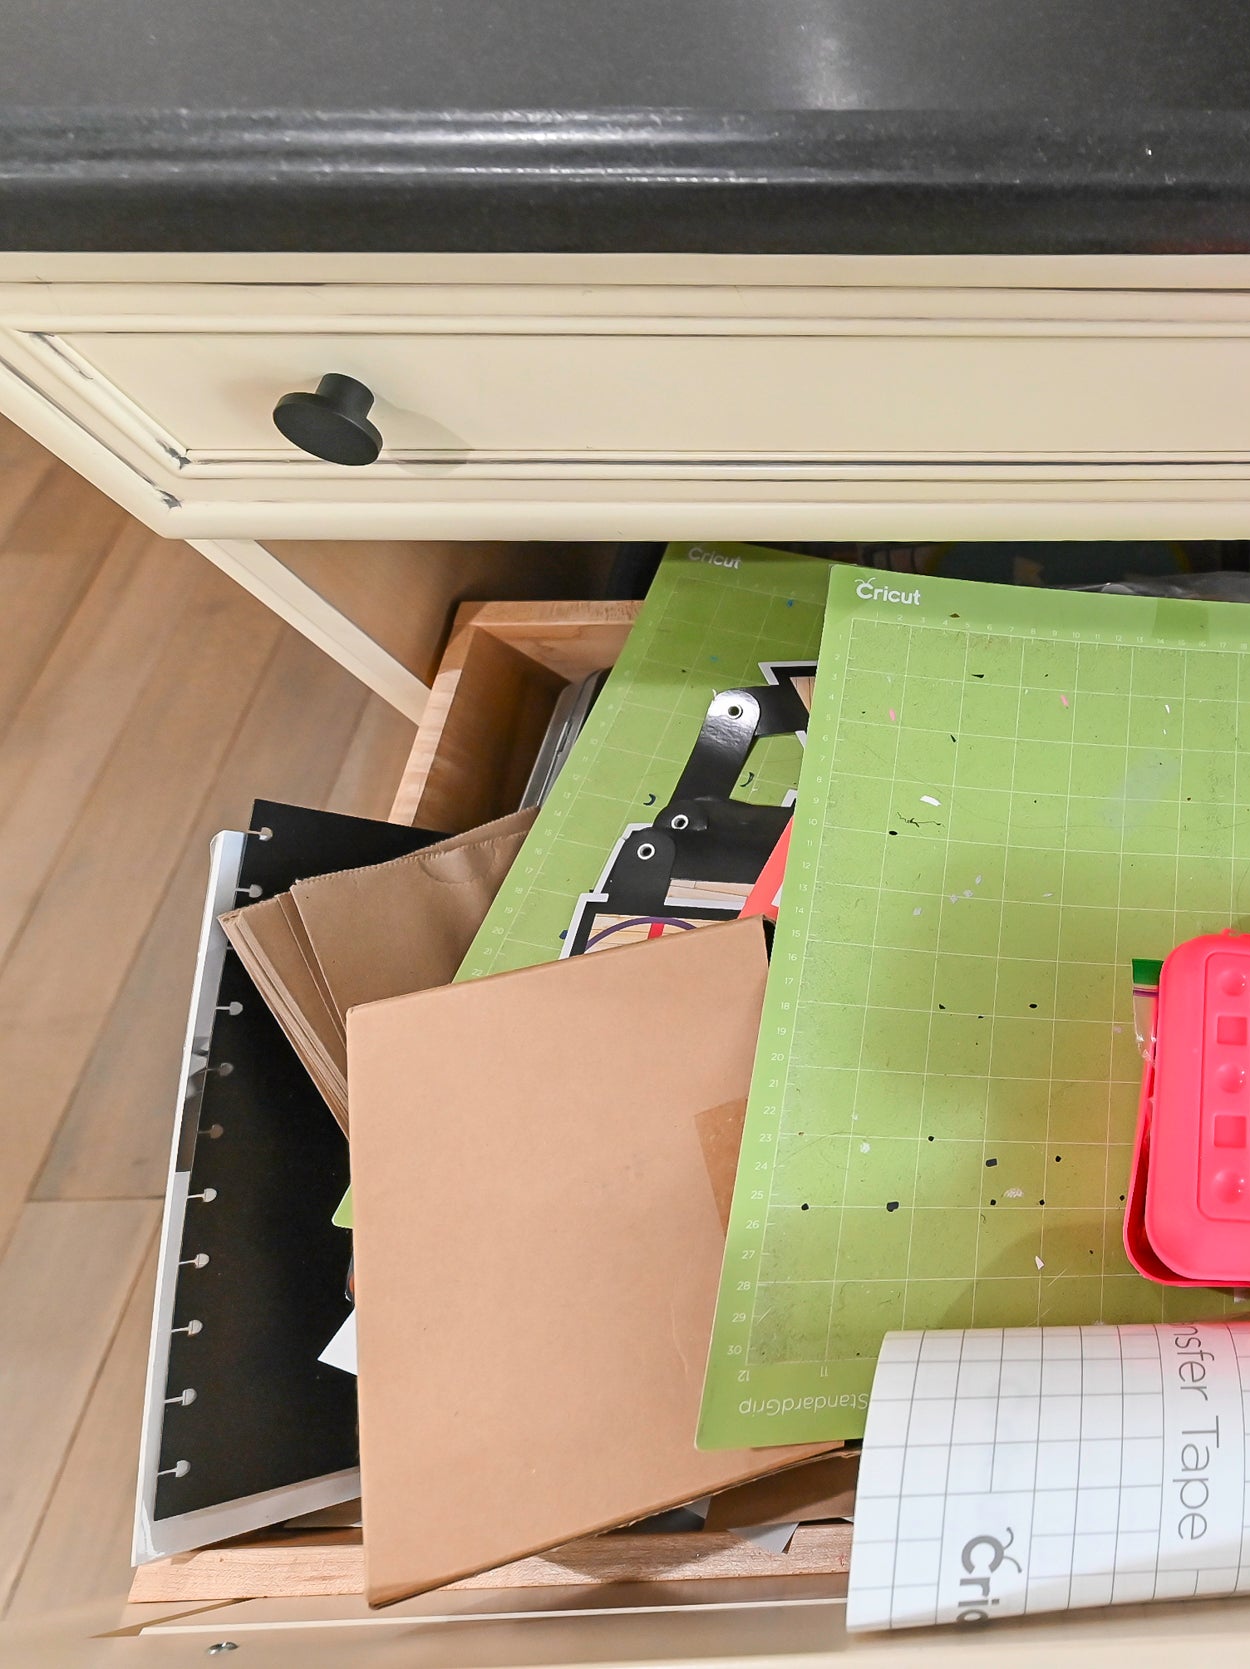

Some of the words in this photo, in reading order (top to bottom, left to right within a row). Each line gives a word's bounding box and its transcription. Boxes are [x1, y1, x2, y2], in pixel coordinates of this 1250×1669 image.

[688, 542, 742, 569] Cricut
[855, 577, 921, 606] Cricut
[788, 953, 797, 961] 16
[781, 1002, 790, 1010] 18
[777, 1027, 786, 1035] 19
[771, 1053, 784, 1061] 20
[768, 1079, 779, 1088] 21
[763, 1106, 776, 1114] 22
[759, 1133, 772, 1142] 23
[754, 1162, 768, 1170] 24
[751, 1191, 764, 1199] 25
[746, 1220, 760, 1229] 26
[741, 1250, 755, 1259] 27
[736, 1281, 751, 1291] 28
[732, 1313, 746, 1323] 29
[728, 1345, 742, 1355] 30
[1167, 1322, 1215, 1401] nsfer
[737, 1370, 750, 1382] 12
[739, 1393, 869, 1417] StandardGrip
[1172, 1415, 1219, 1540] Tape
